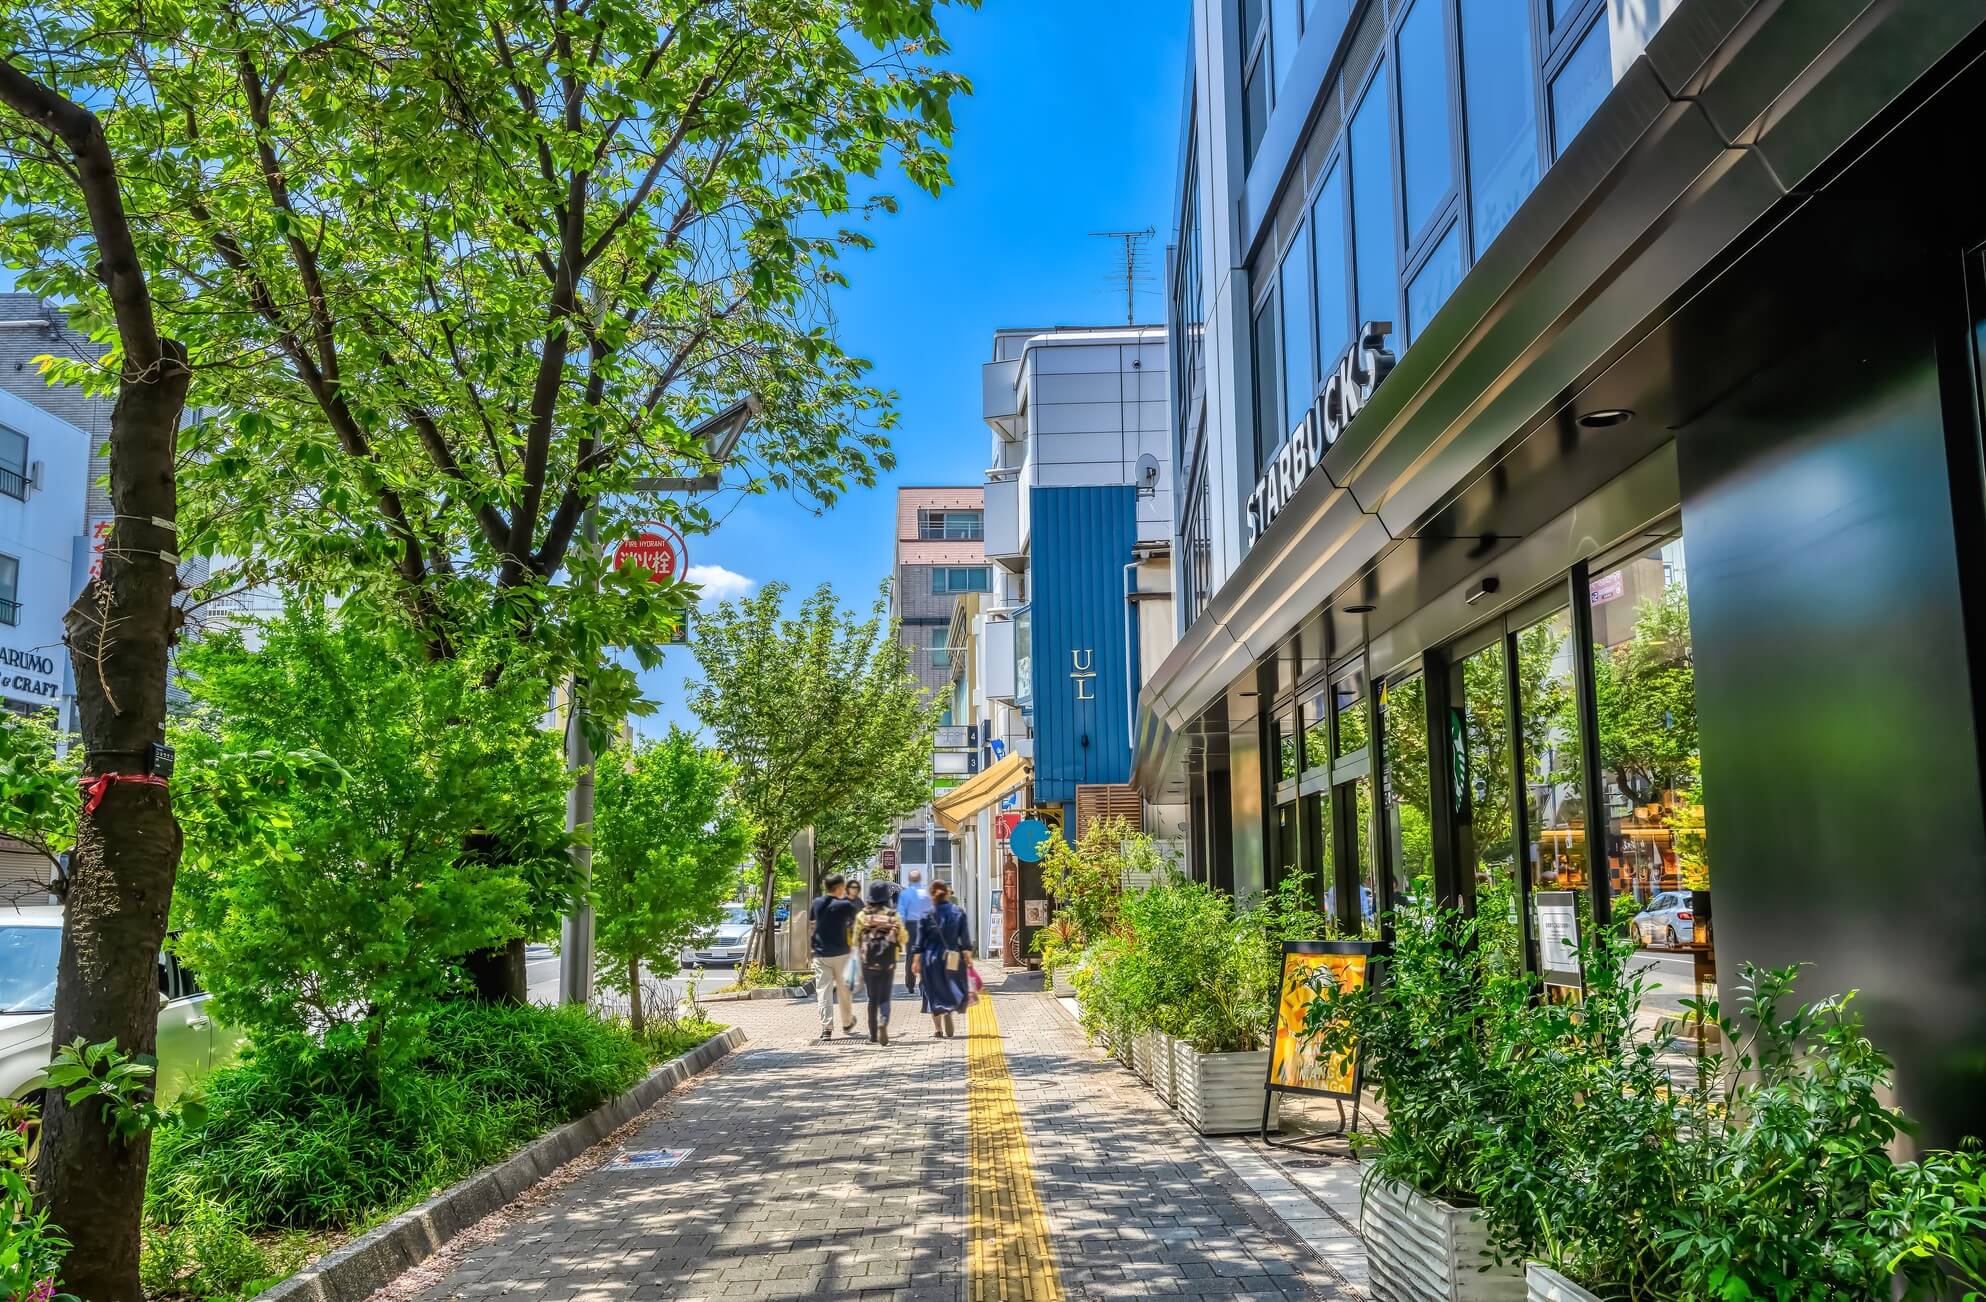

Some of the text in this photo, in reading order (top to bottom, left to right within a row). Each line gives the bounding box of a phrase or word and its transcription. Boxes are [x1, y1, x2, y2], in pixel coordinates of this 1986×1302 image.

[1246, 320, 1393, 548] STARBUCKS
[625, 540, 666, 549] FIRE HYDRANT
[13, 675, 59, 698] CRAFT
[970, 732, 976, 741] 4
[970, 758, 976, 767] 3
